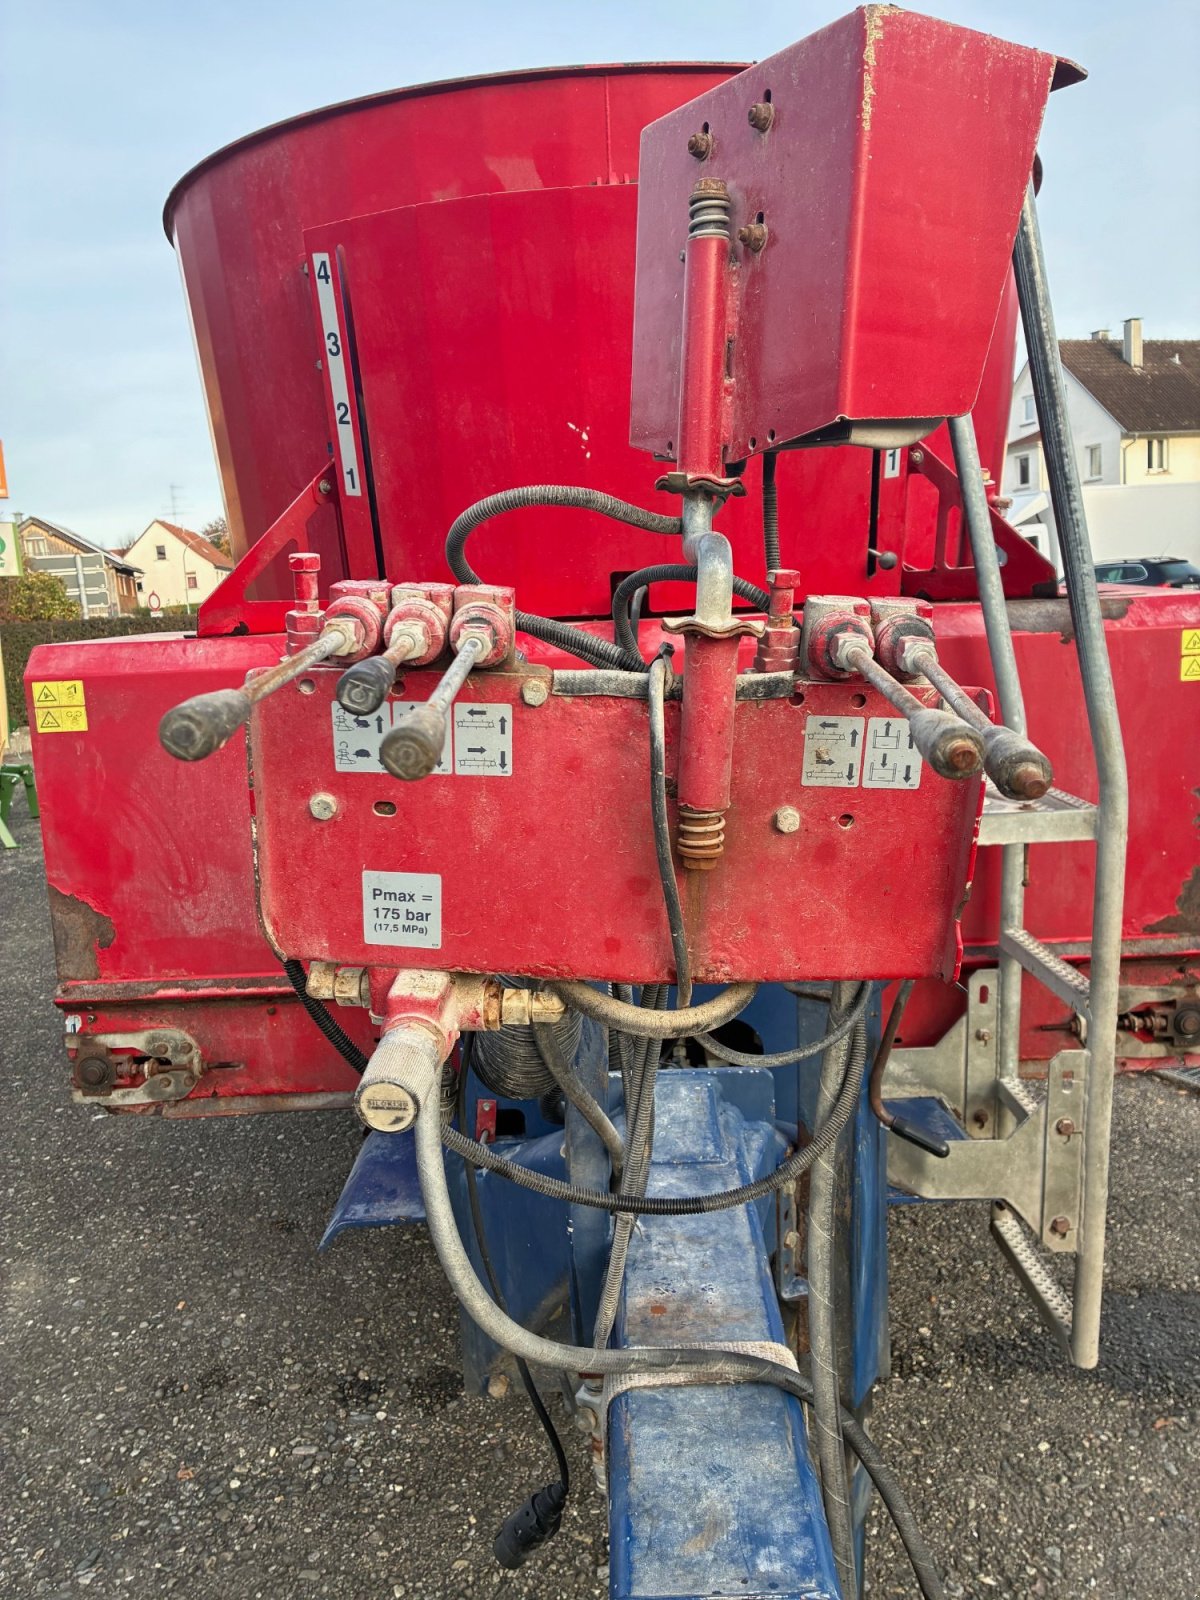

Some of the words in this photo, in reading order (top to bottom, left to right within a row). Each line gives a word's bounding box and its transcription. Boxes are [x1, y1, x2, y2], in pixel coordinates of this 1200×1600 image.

[317, 261, 331, 285] 4
[327, 332, 340, 356] 3
[337, 402, 350, 424] 2
[888, 449, 897, 471] 1
[346, 468, 356, 489] 1
[372, 888, 416, 903] Pmax
[374, 907, 400, 920] 175
[405, 908, 432, 922] bar
[374, 923, 399, 933] (17,5
[402, 924, 428, 936] MPa)
